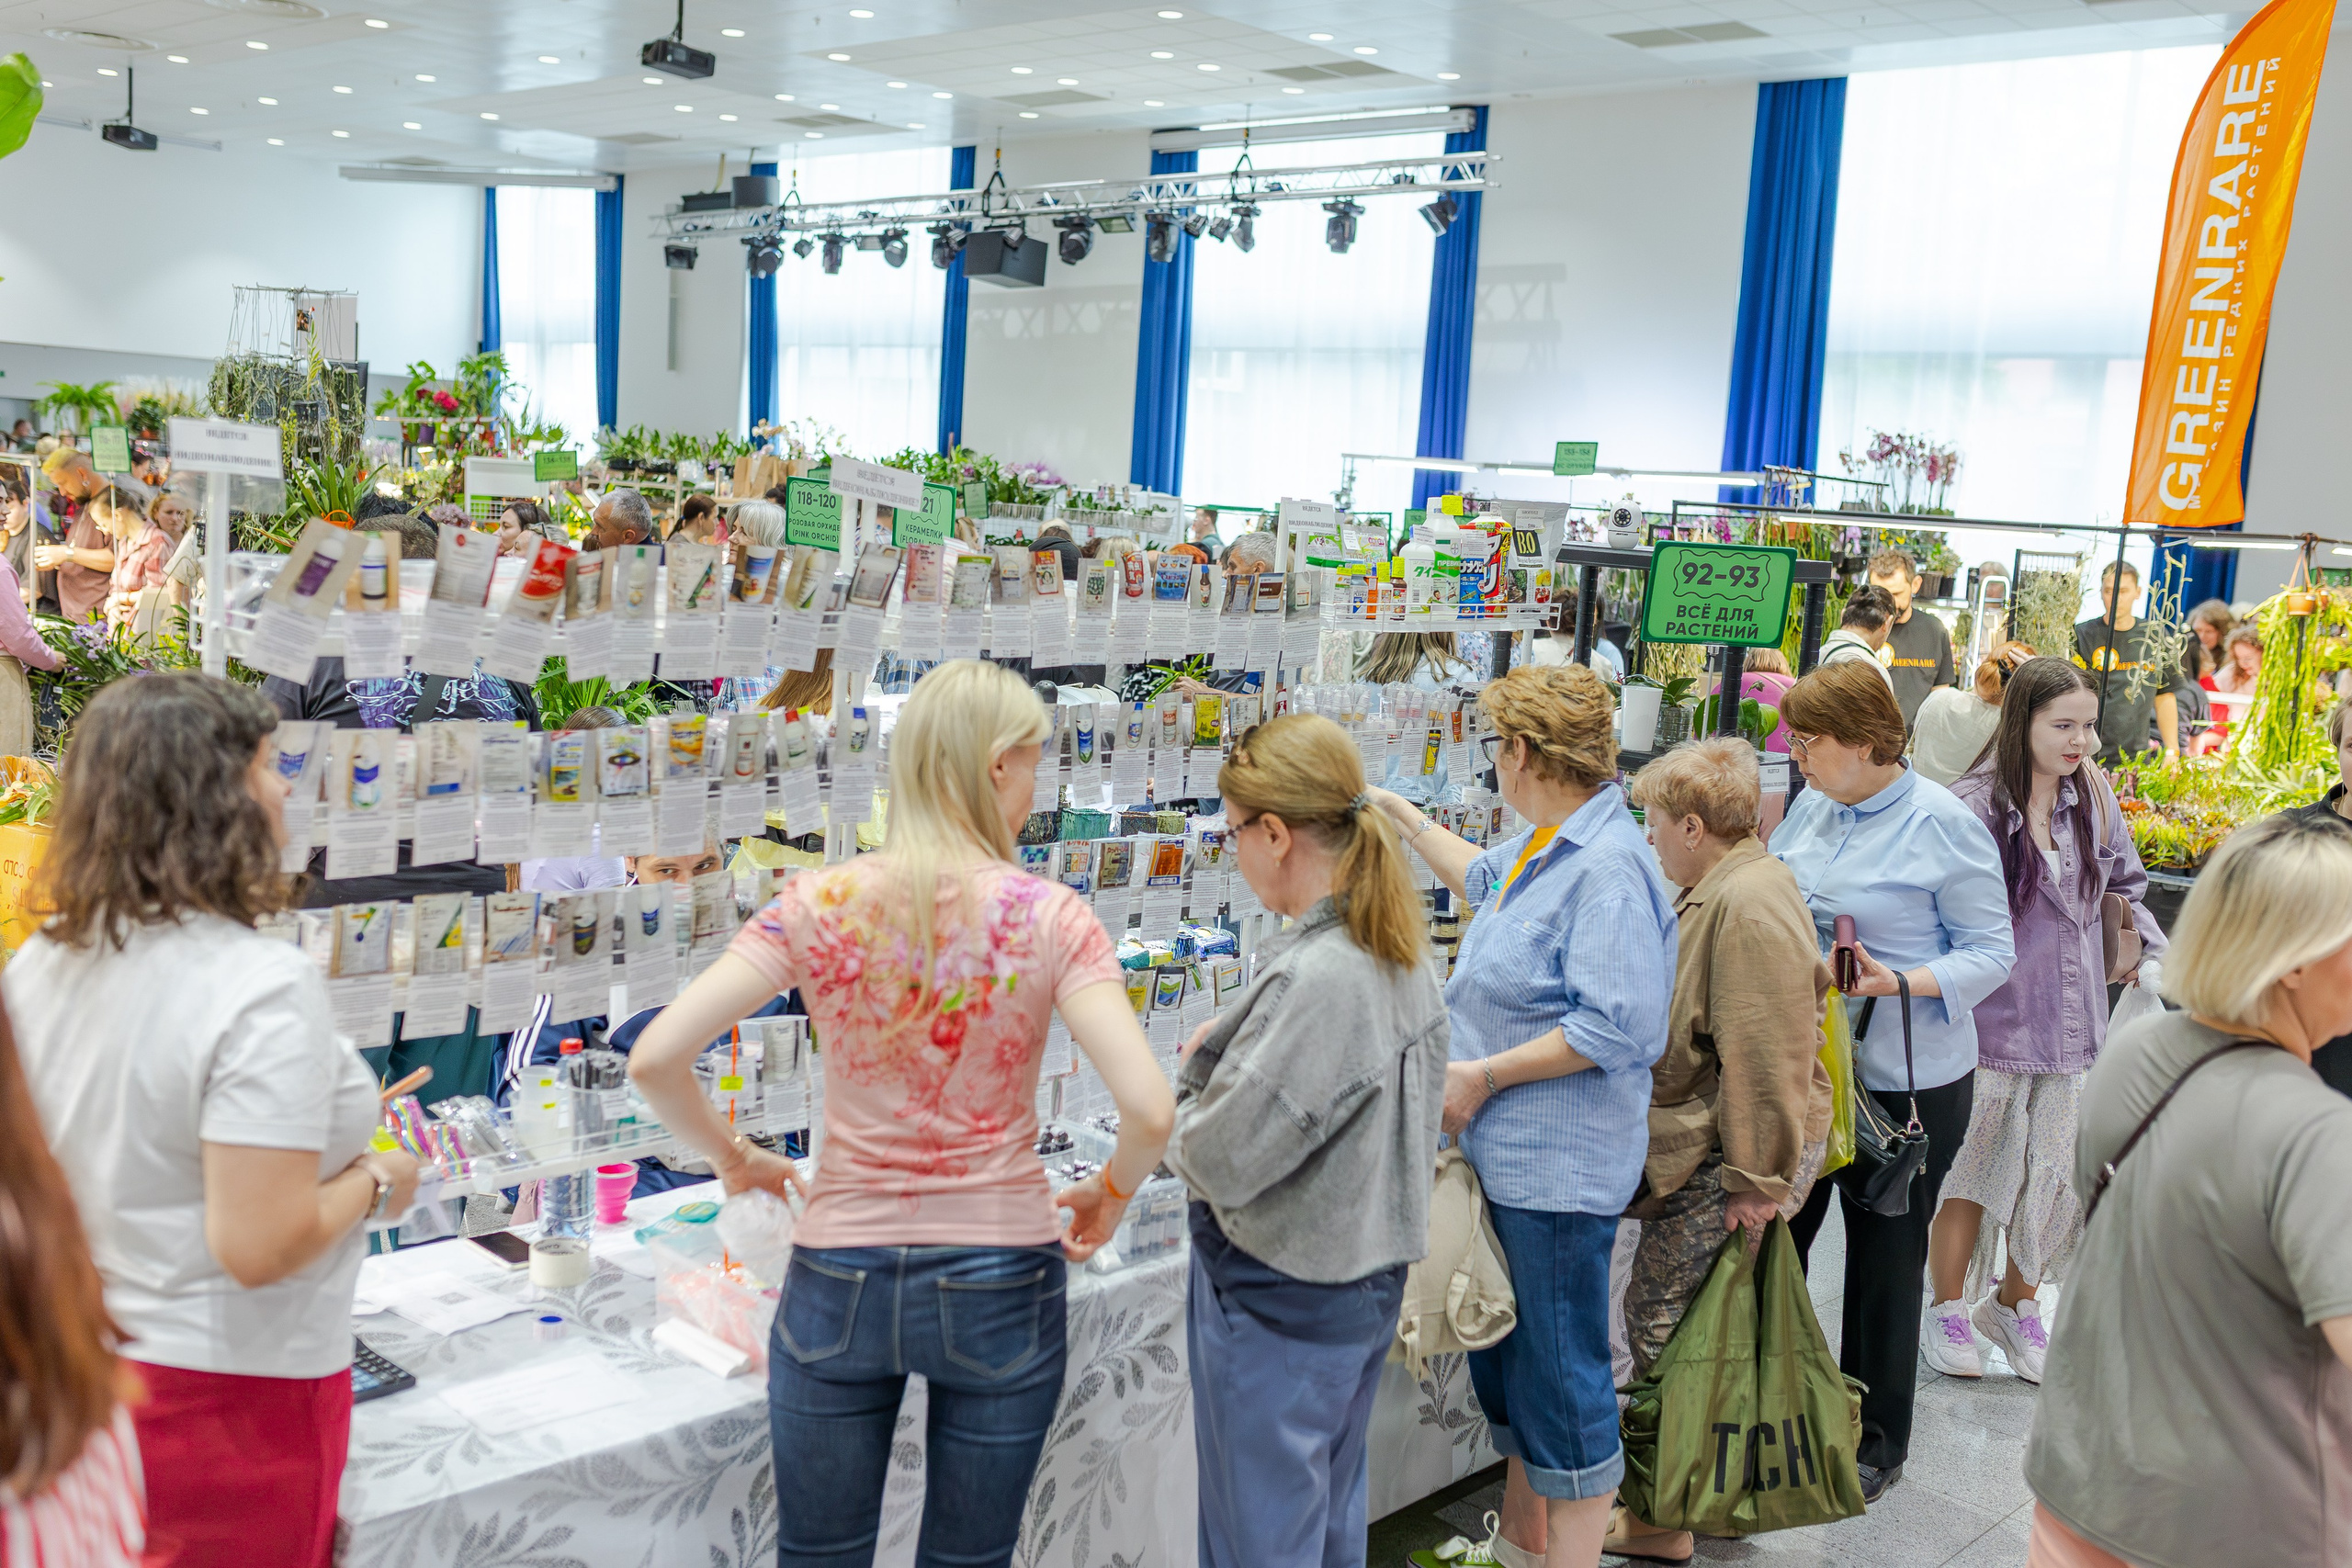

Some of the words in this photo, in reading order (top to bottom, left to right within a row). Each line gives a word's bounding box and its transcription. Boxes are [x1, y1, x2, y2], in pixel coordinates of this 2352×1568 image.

[2243, 57, 2281, 218] РАСТЕНИЙ
[2159, 59, 2267, 511] GREENRARE
[797, 491, 837, 510] 118-120
[922, 496, 934, 514] 21
[788, 517, 816, 527] РОЗОВАЯ
[816, 522, 842, 533] ОРХИДЕ
[905, 523, 944, 540] КЕРАМЕЛКИ
[792, 528, 809, 539] (PINK
[810, 532, 840, 544] ORCHID)
[1682, 562, 1761, 589] 92-93
[1676, 603, 1712, 619] ВСЁ
[1715, 606, 1755, 623] ДЛЯ
[1665, 621, 1759, 639] РАСТЕНИЙ
[1712, 1414, 1817, 1495] TCH
